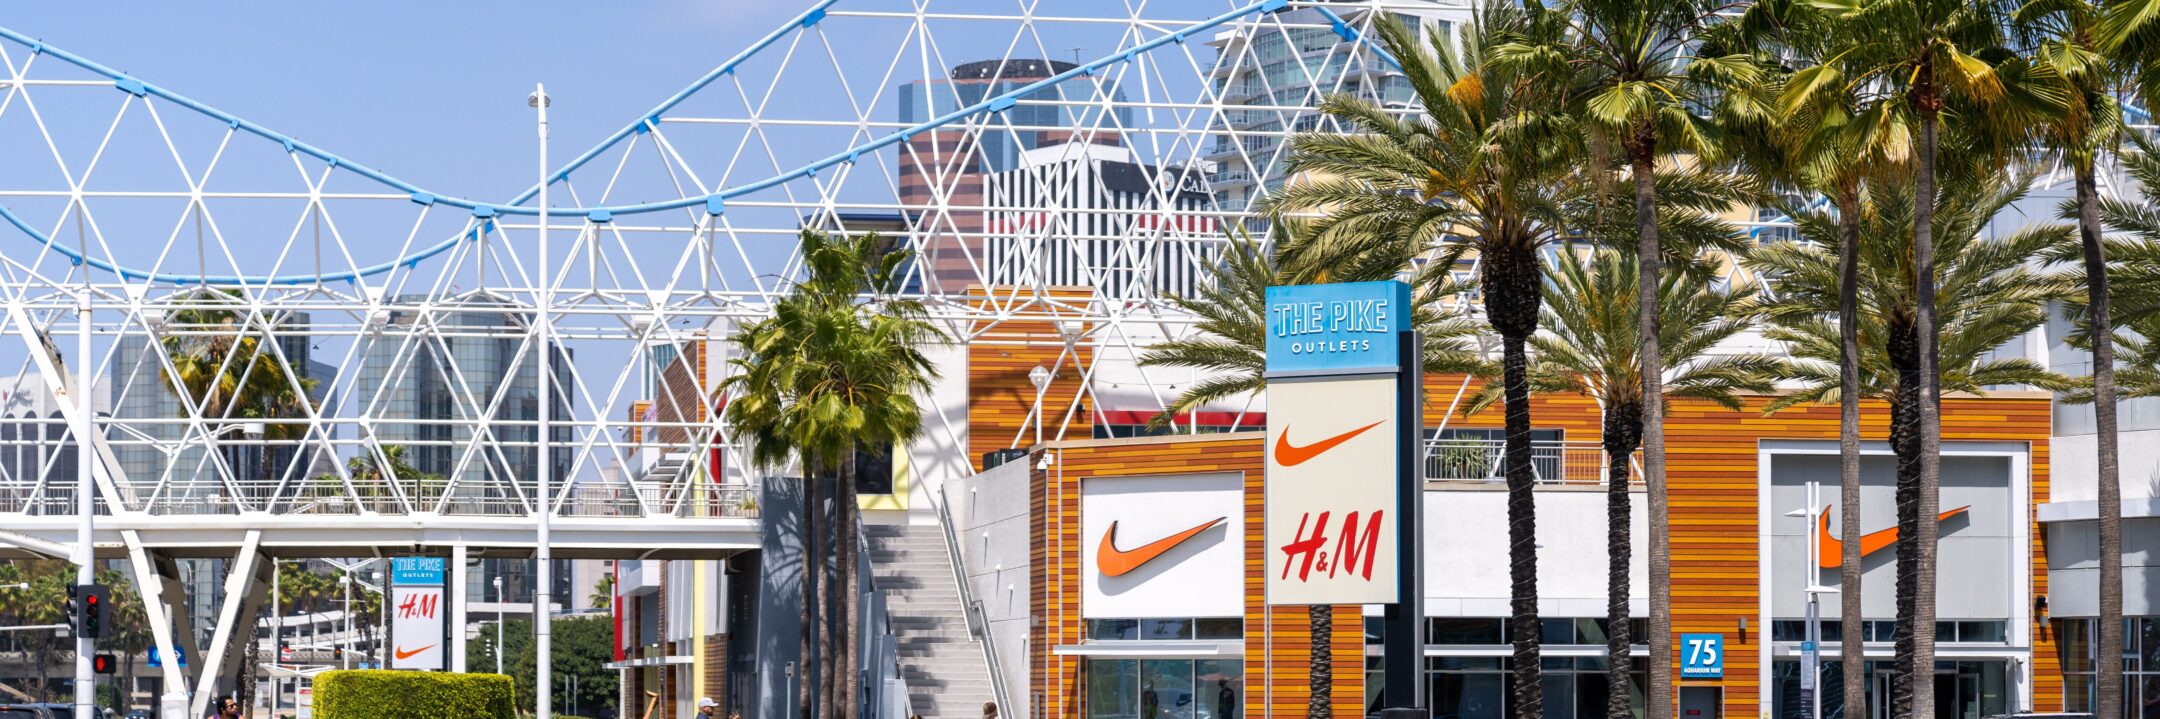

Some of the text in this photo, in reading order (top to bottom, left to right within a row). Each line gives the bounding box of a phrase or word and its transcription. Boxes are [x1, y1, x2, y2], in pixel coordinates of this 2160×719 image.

[1273, 298, 1388, 337] THE PIKE
[1291, 340, 1370, 354] OUTLETS
[1281, 509, 1384, 583] H&M
[398, 559, 441, 572] THE PIKE
[398, 593, 438, 619] H&M
[1689, 640, 1717, 666] 75
